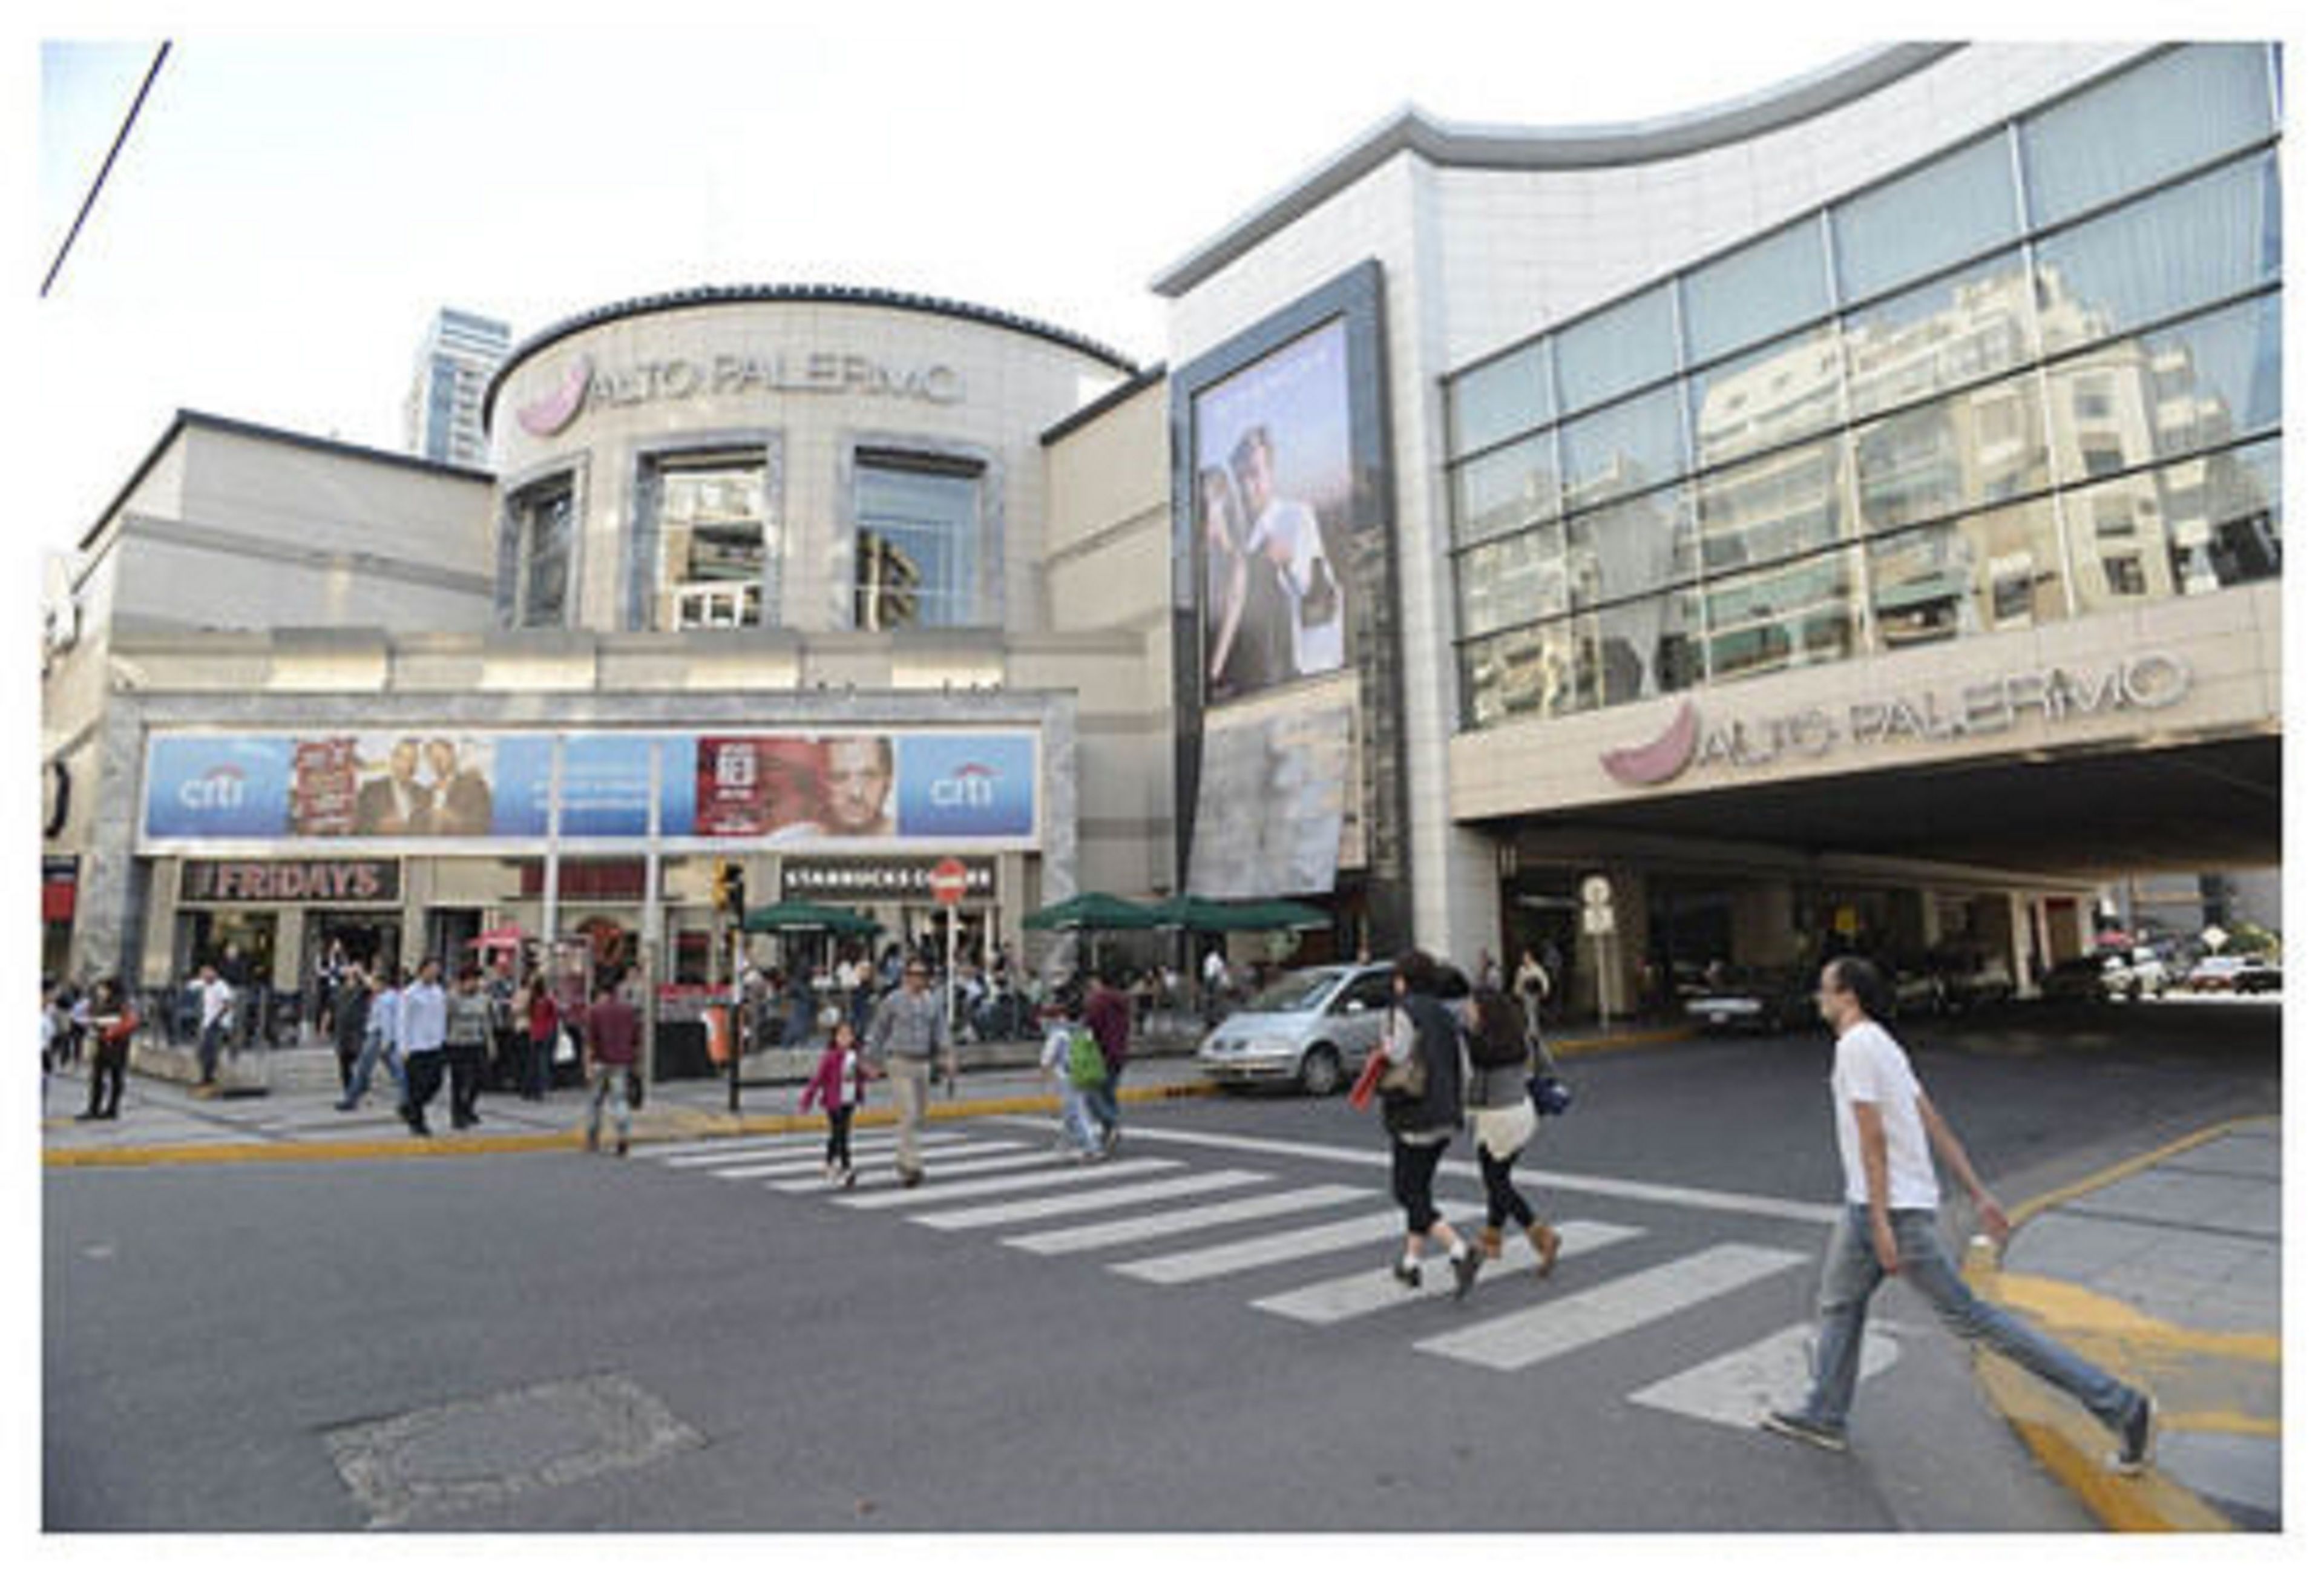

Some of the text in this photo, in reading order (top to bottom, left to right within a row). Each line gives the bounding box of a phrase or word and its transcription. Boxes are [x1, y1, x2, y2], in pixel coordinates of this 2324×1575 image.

[589, 353, 967, 406] ALTO PALERMO
[1697, 651, 2191, 766] ALTO PALERMO
[179, 768, 244, 809] citi
[930, 769, 994, 807] citi
[217, 861, 379, 897] FRIDAYS
[785, 867, 908, 889] STARBUCKS
